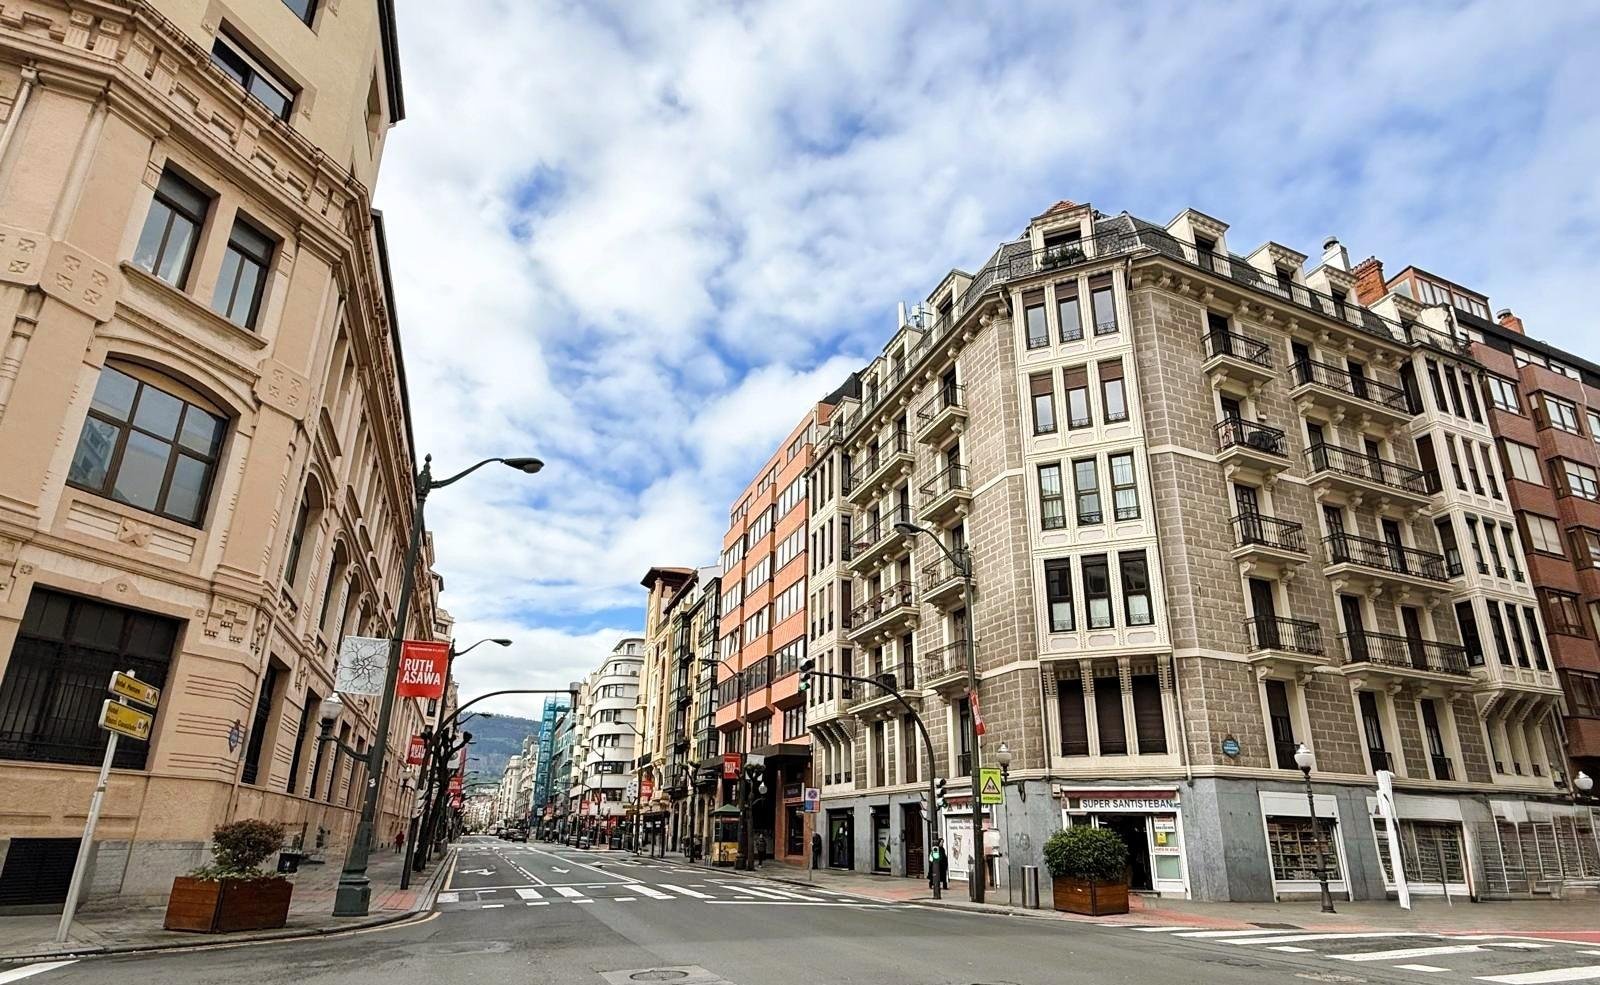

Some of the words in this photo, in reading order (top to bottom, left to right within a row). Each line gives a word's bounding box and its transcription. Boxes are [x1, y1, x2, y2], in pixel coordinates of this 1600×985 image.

[404, 658, 434, 673] RUTH
[402, 672, 441, 686] ASAWA
[1082, 799, 1110, 809] SUPER
[1112, 799, 1173, 809] SANTISTEBAN
